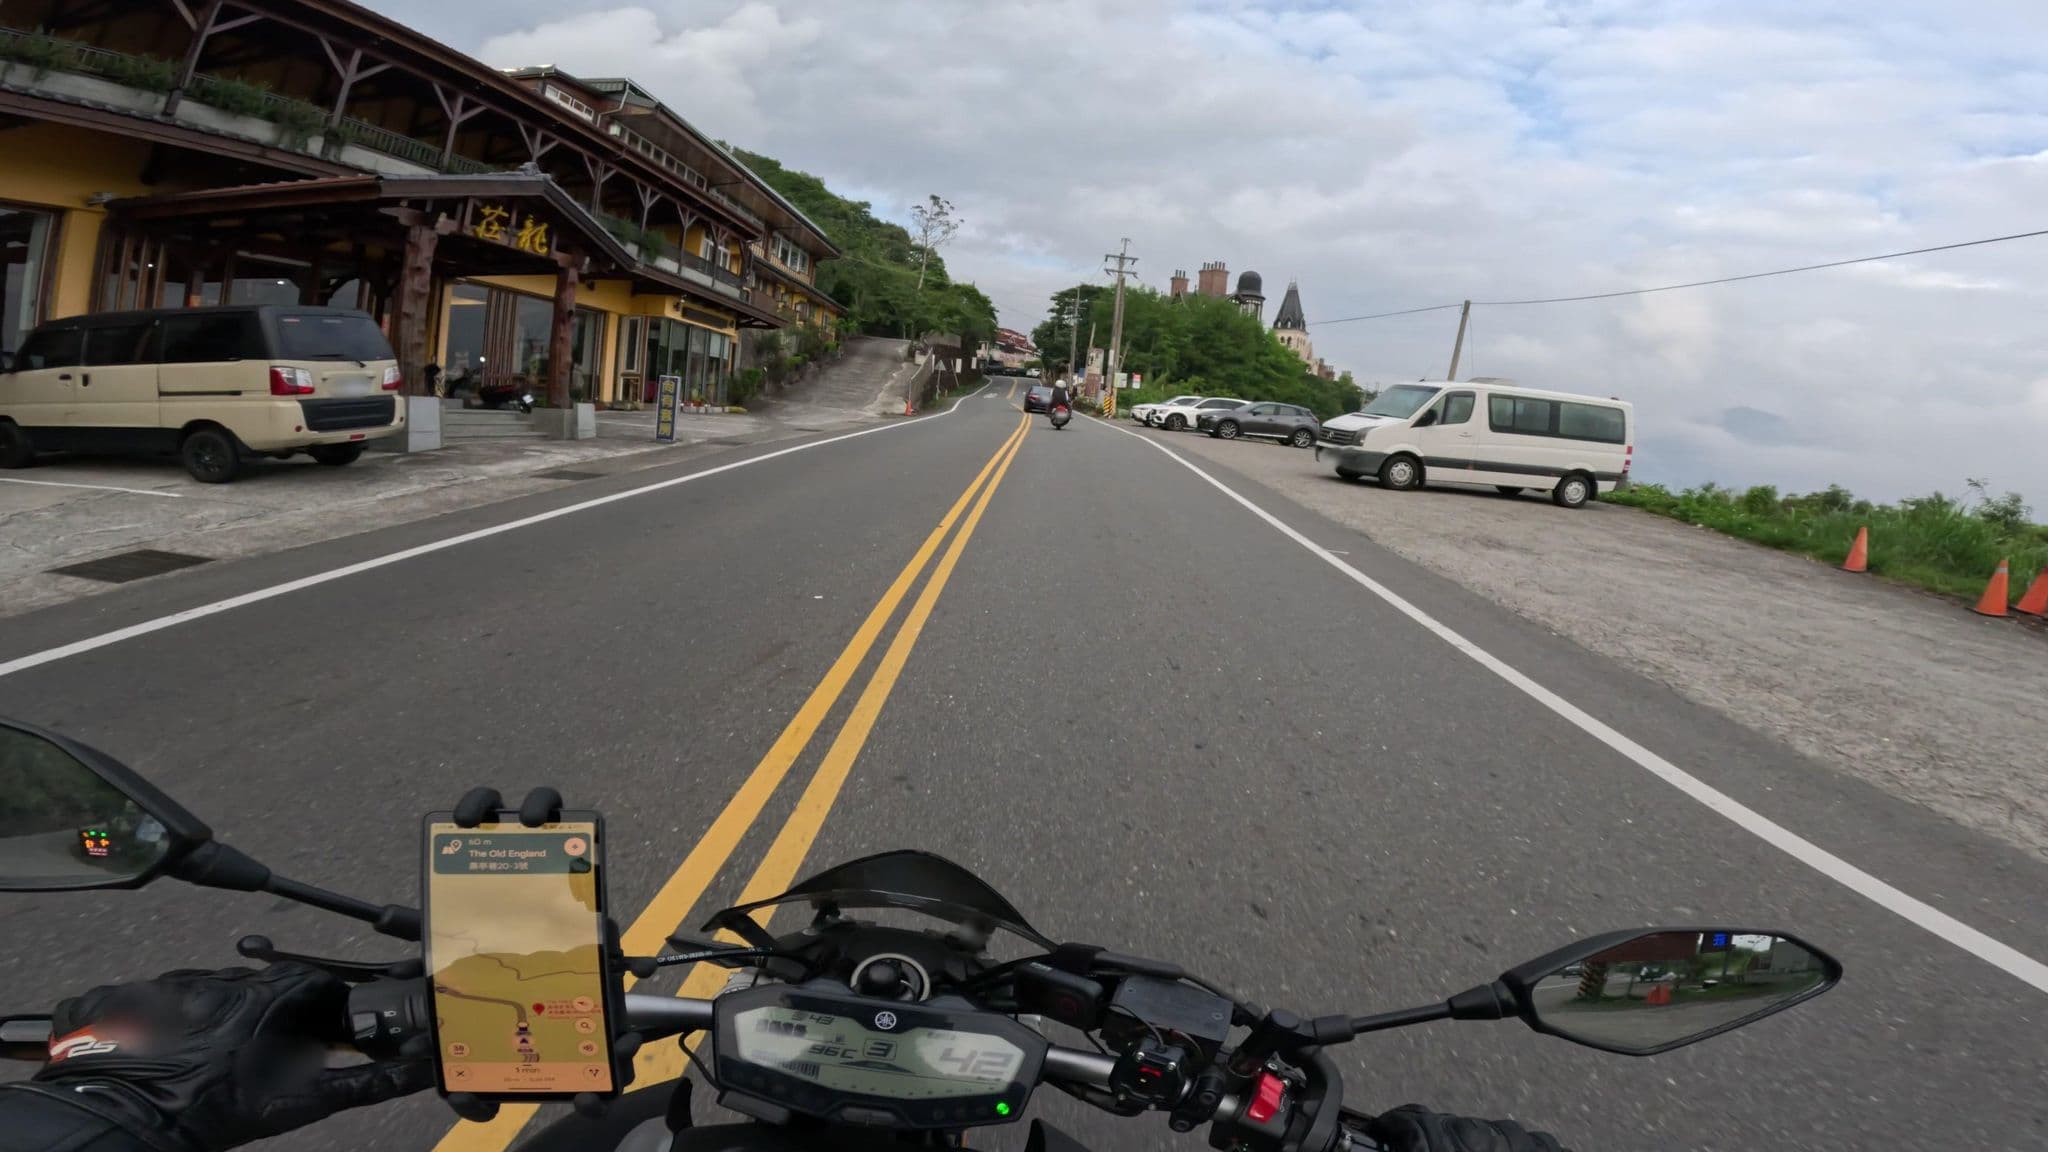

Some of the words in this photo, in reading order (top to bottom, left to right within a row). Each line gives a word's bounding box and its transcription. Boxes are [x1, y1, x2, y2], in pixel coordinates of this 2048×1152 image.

[489, 849, 506, 857] Old
[508, 849, 547, 859] England
[866, 1041, 894, 1057] 3
[940, 1048, 1014, 1076] 42
